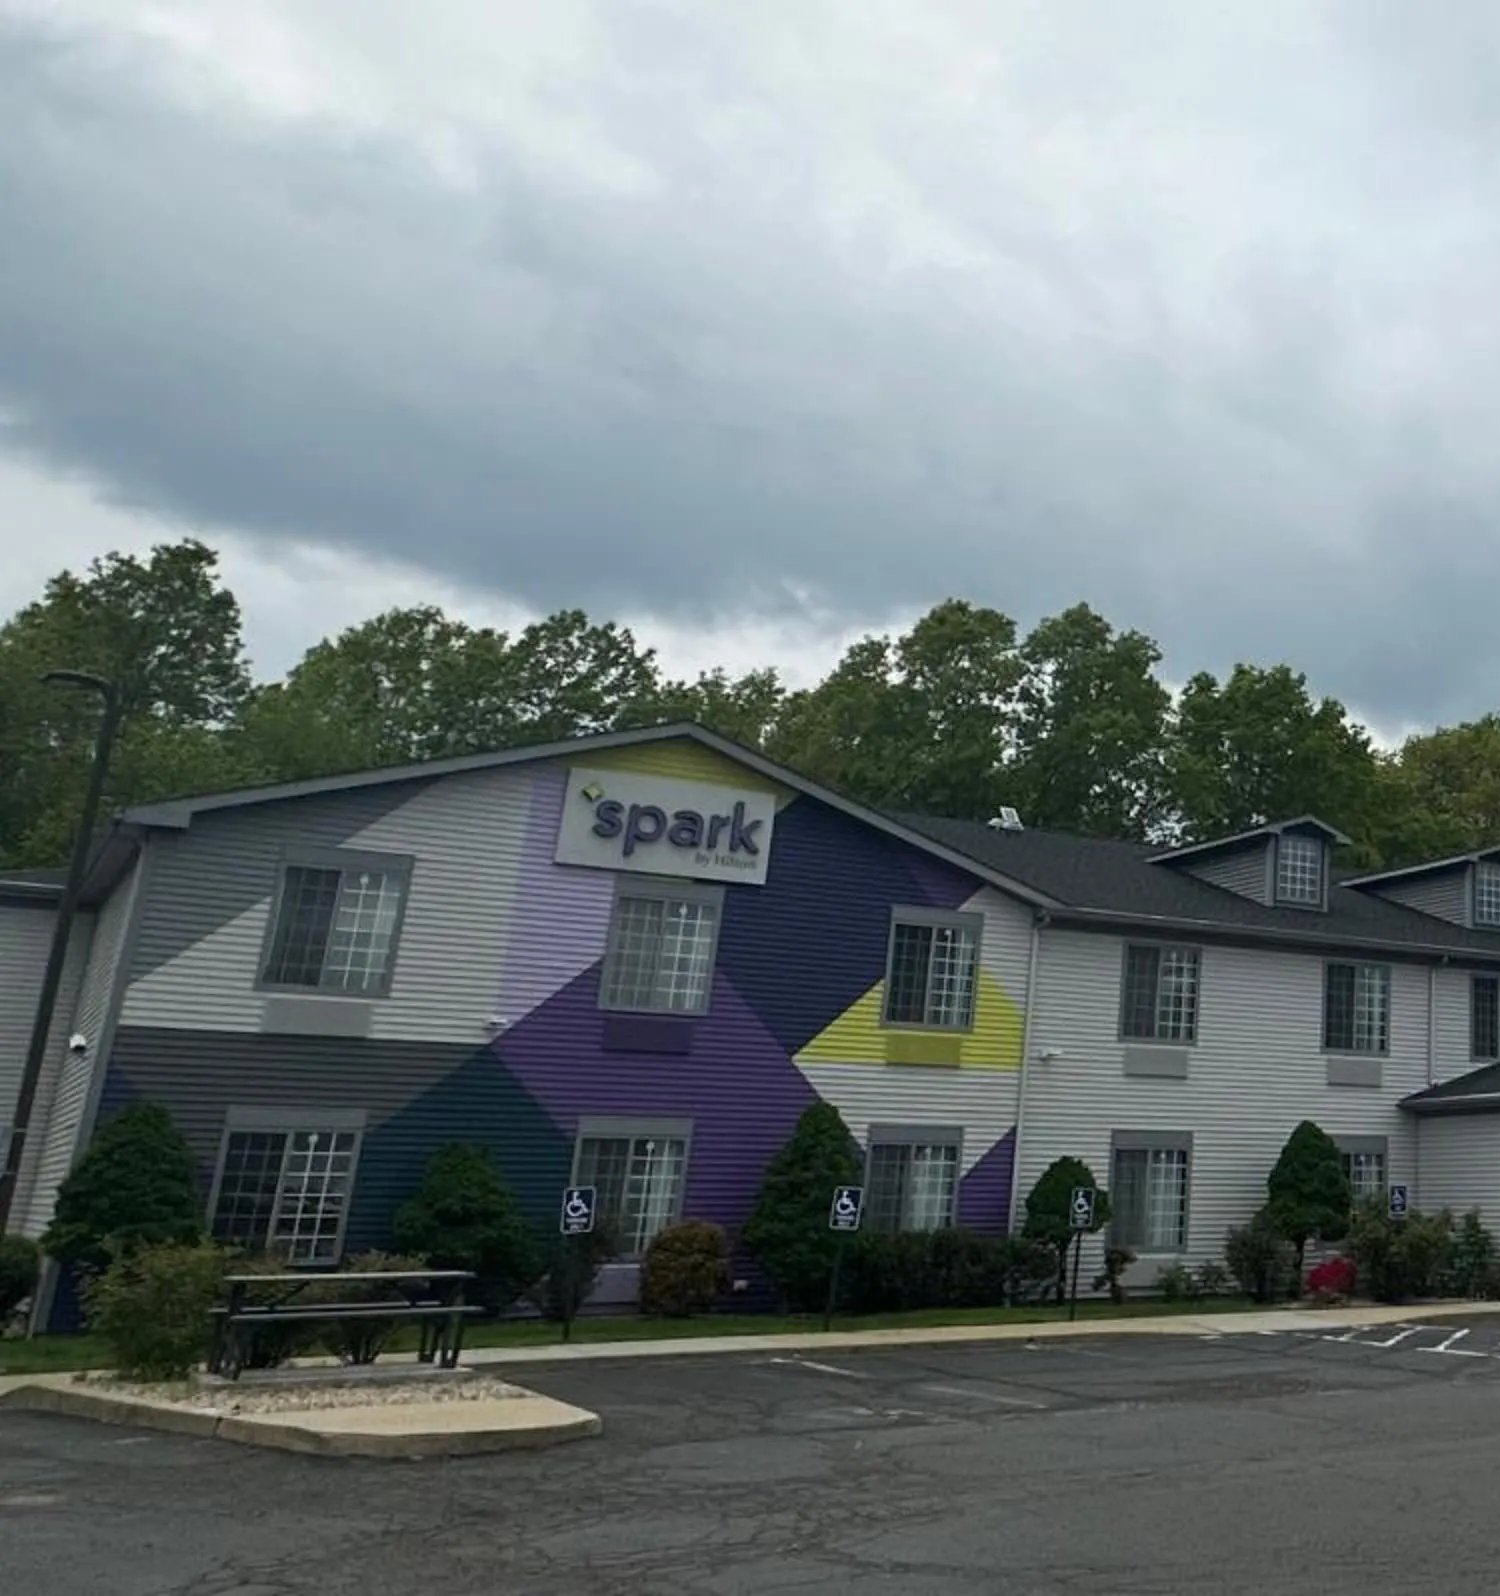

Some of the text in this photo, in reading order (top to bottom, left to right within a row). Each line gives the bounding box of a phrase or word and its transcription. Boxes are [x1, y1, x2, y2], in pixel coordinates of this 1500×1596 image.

[592, 799, 764, 858] spark
[695, 851, 757, 870] by Hilton
